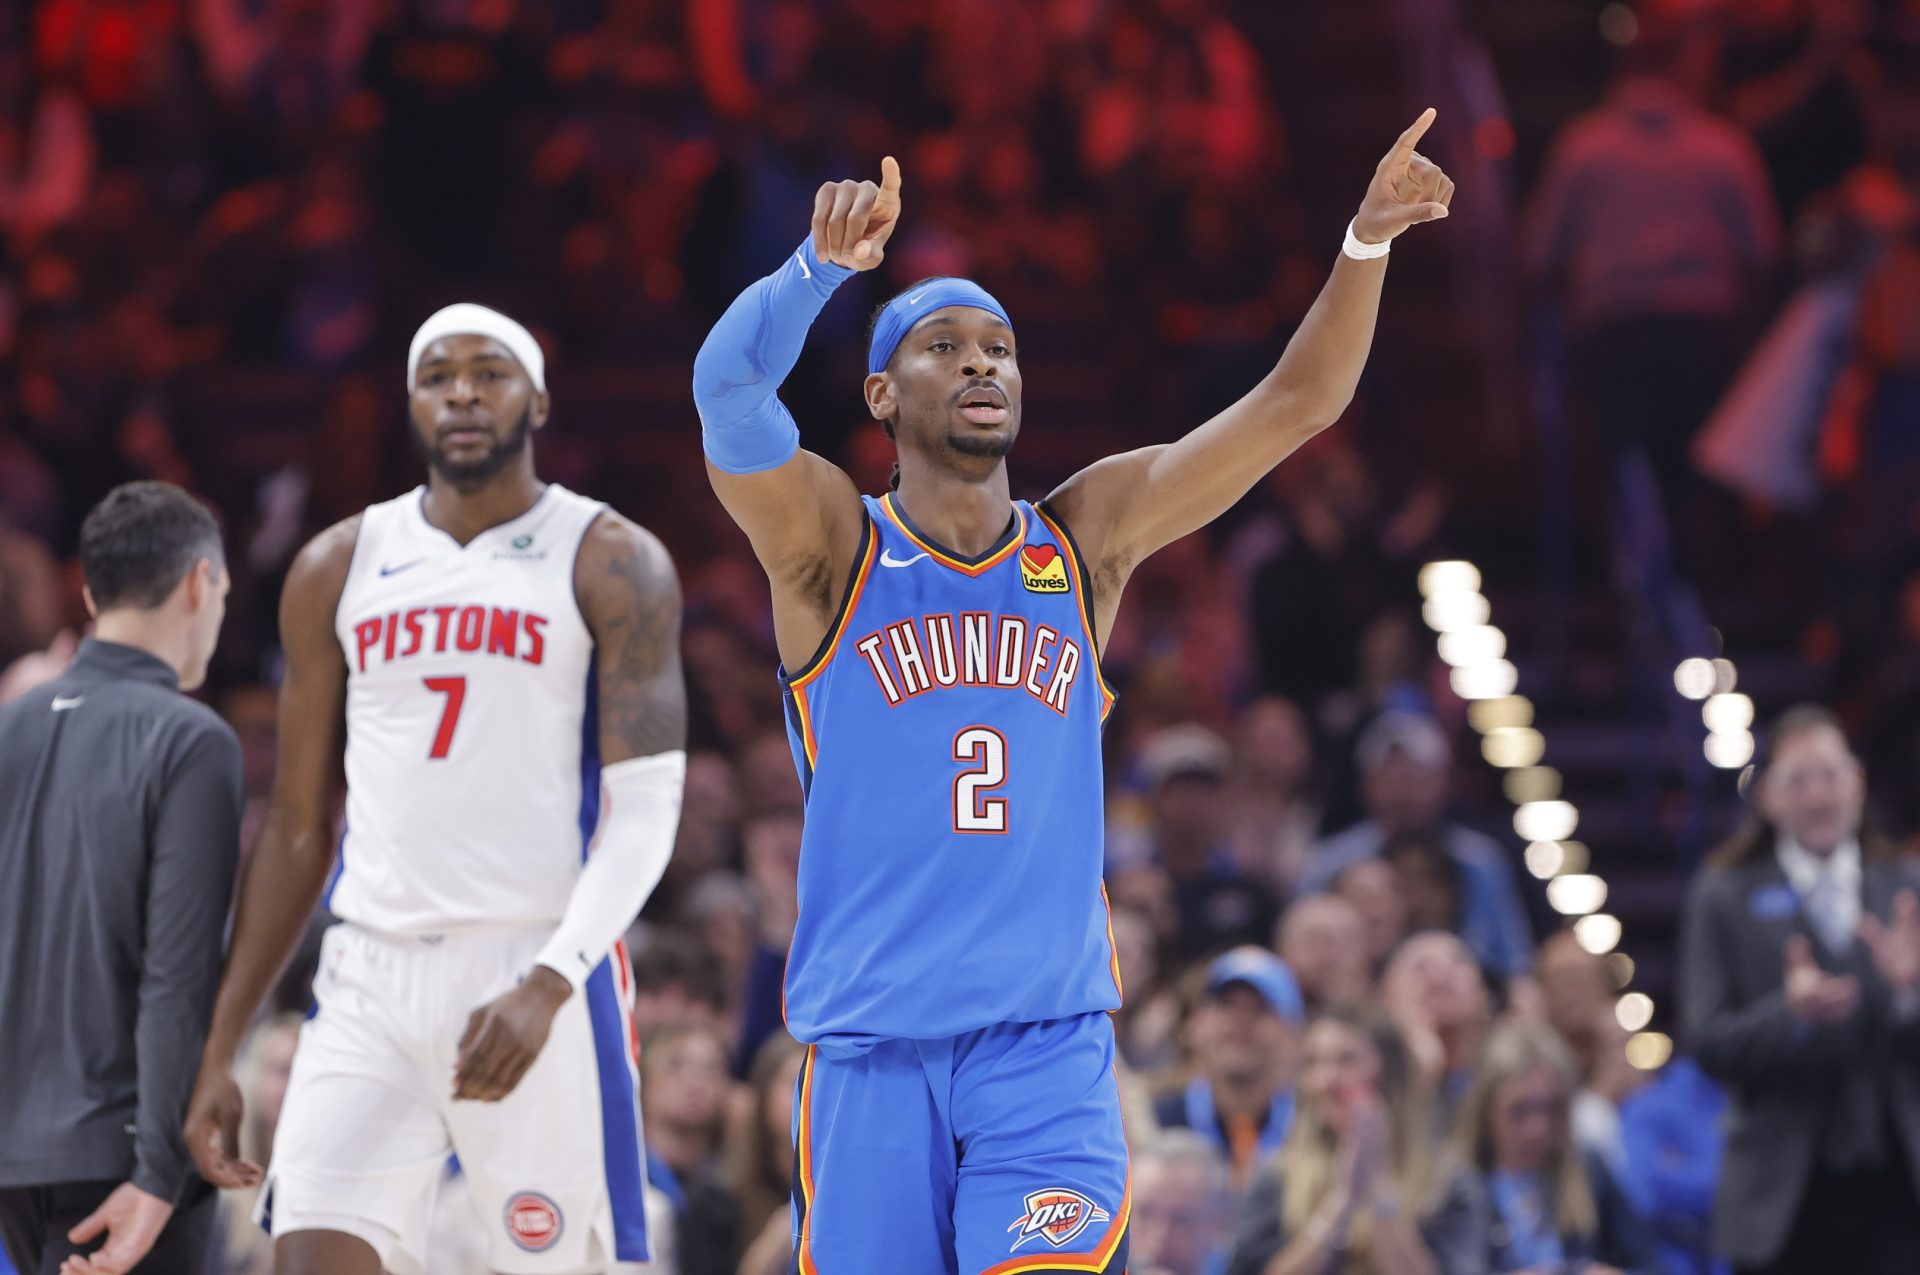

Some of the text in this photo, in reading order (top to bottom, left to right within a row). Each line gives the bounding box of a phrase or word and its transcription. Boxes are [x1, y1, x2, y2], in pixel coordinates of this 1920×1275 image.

[354, 605, 549, 672] PISTONS
[855, 611, 1080, 717] THUNDER
[422, 676, 466, 759] 7
[952, 724, 1008, 835] 2
[1023, 1202, 1080, 1235] OKC
